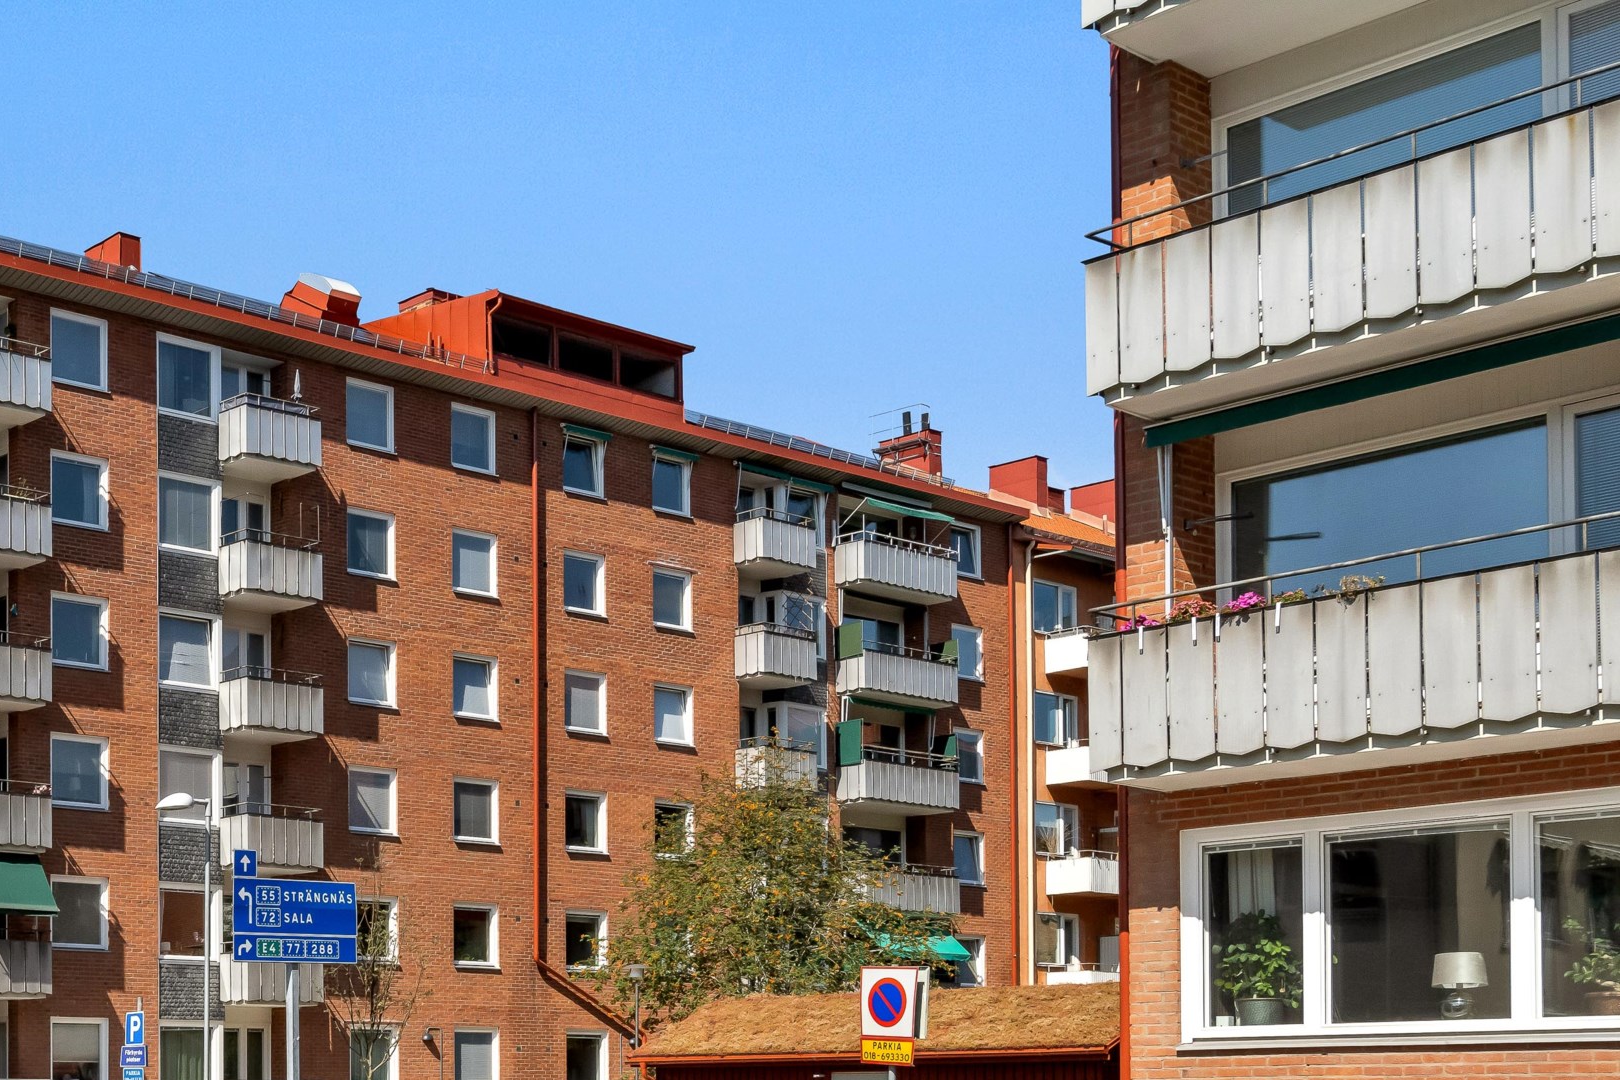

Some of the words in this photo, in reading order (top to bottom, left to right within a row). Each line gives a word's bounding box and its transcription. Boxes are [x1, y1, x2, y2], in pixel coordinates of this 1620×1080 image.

[261, 890, 276, 901] 55
[283, 889, 353, 905] STRÄNGNÄS
[261, 912, 276, 923] 72
[283, 912, 313, 924] SALA
[262, 942, 276, 954] E4
[286, 943, 300, 954] 77
[311, 944, 334, 955] 288
[129, 1015, 141, 1042] P
[872, 1041, 902, 1051] PARKIA
[863, 1051, 910, 1062] 018-693330
